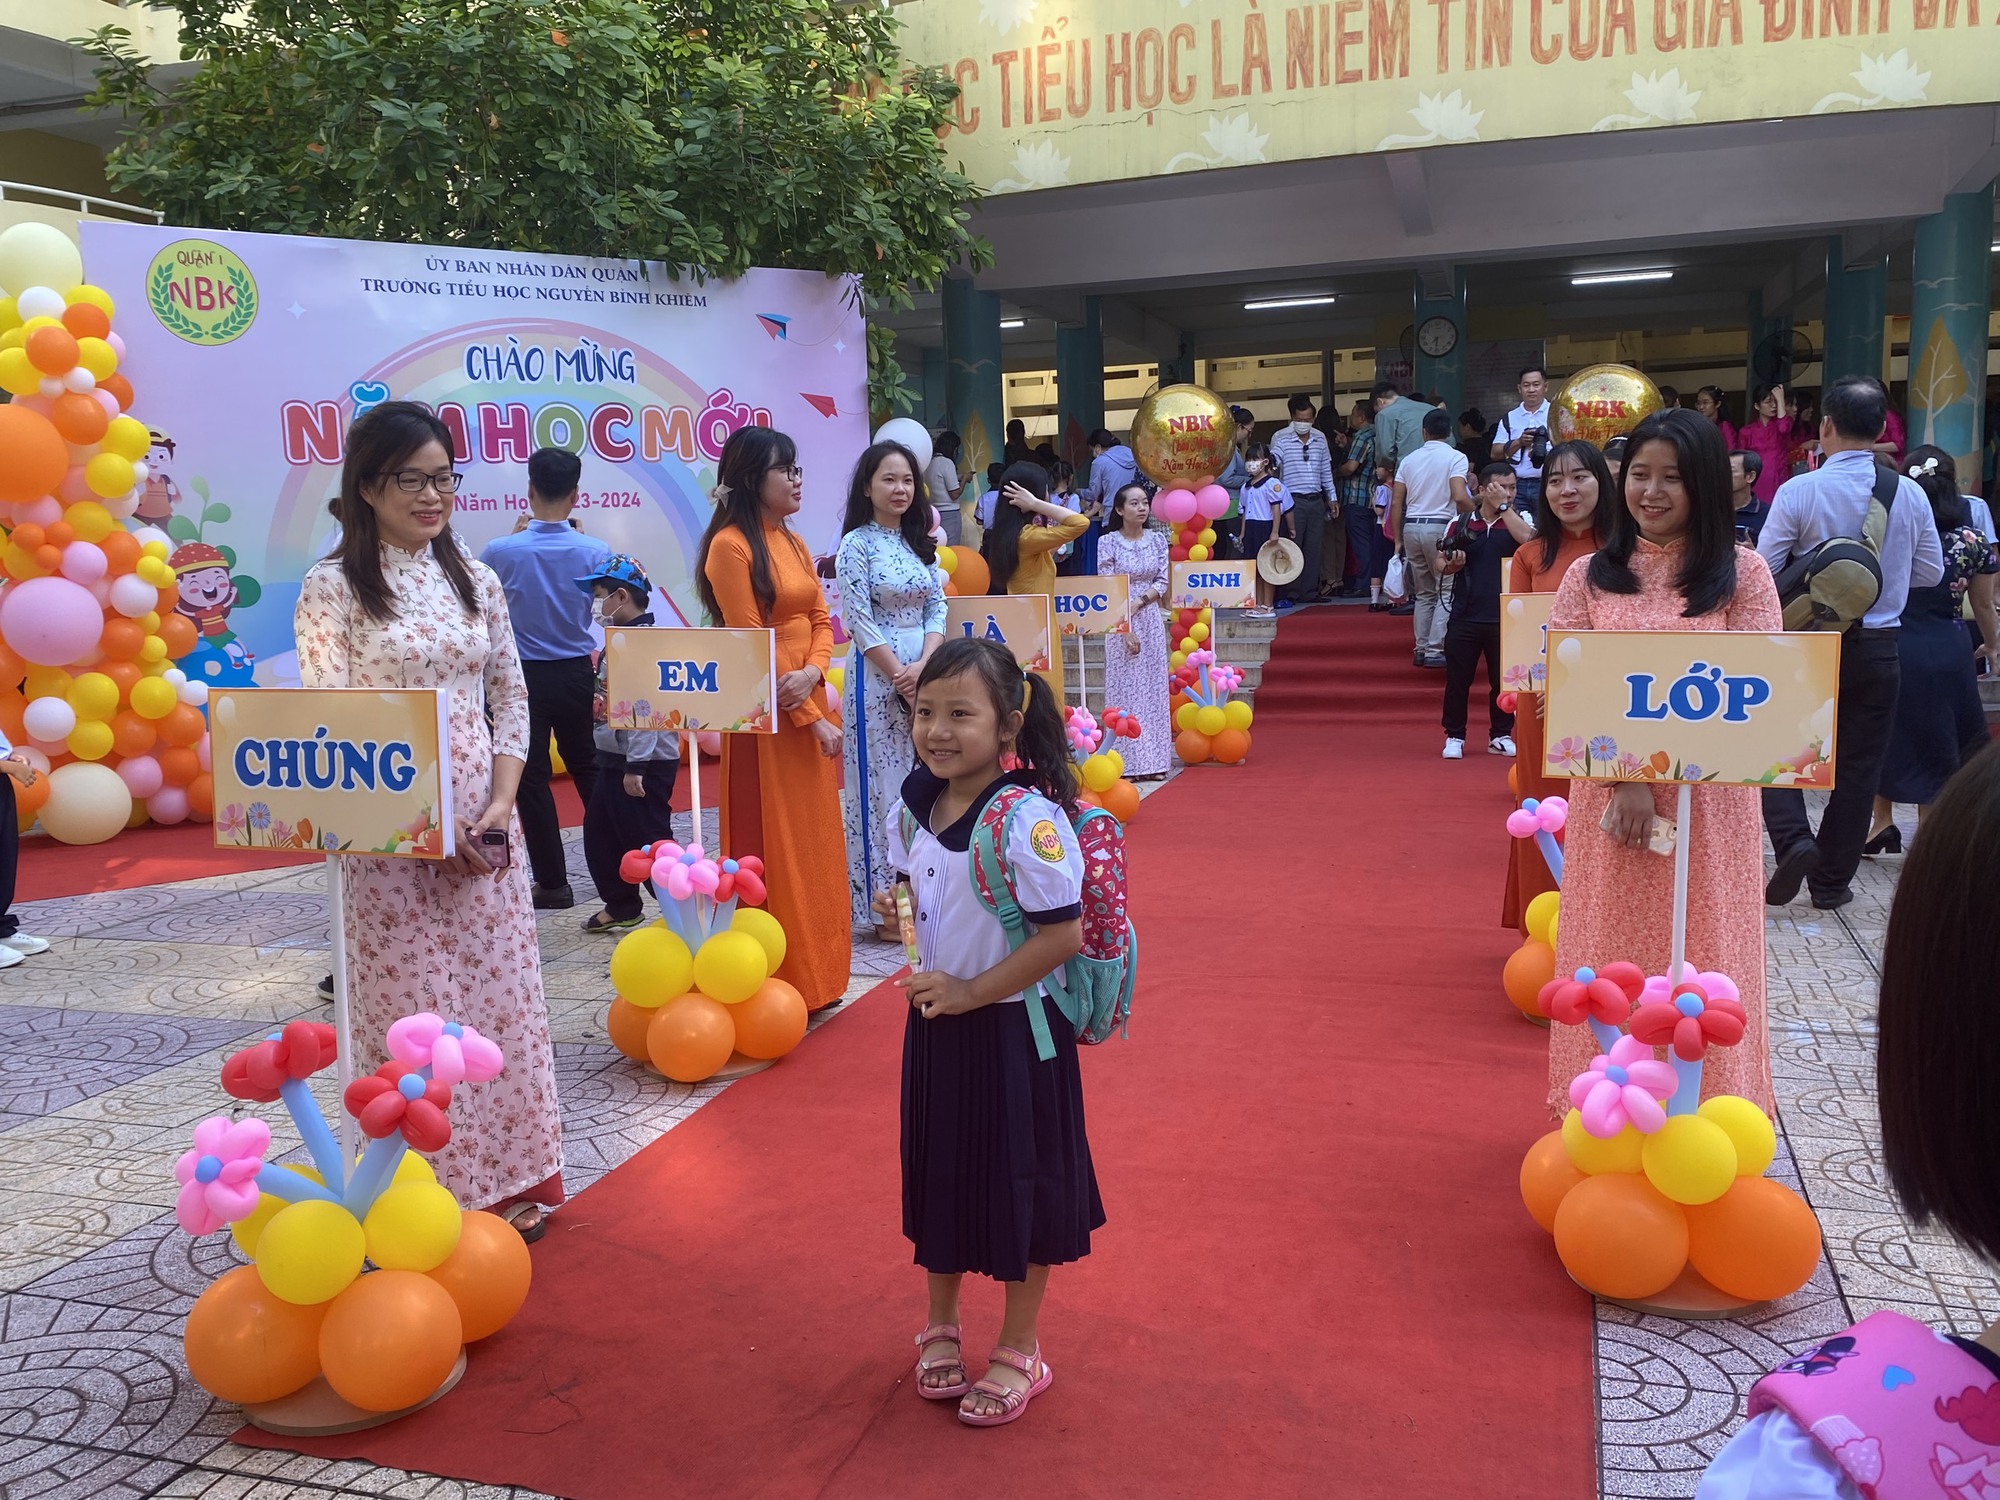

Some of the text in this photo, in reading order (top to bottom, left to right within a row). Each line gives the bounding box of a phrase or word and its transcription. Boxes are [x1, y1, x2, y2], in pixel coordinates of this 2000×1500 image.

[993, 16, 1090, 129] TIỂU
[1105, 23, 1197, 127] HỌC
[1211, 0, 1273, 100] LÀ
[1434, 0, 1513, 74] TIN
[425, 255, 449, 271] ỦY
[455, 260, 491, 274] BAN
[497, 261, 546, 277] NHÂN
[551, 264, 587, 279] DÂN
[591, 267, 639, 283] QUẬN
[361, 277, 441, 295] TRƯỜNG
[446, 279, 487, 297] TIỂU
[493, 285, 531, 301] HỌC
[466, 337, 634, 384] CHÀO MỪNG
[1575, 400, 1627, 419] NBK
[1168, 415, 1215, 434] NBK
[454, 493, 497, 511] Năm
[504, 494, 529, 515] Họ
[1187, 573, 1240, 589] SINH
[1054, 594, 1108, 618] HỌC
[657, 660, 720, 693] EM
[1625, 662, 1771, 722] LỚP
[235, 727, 416, 792] CHÚNG
[1039, 835, 1060, 849] NBK
